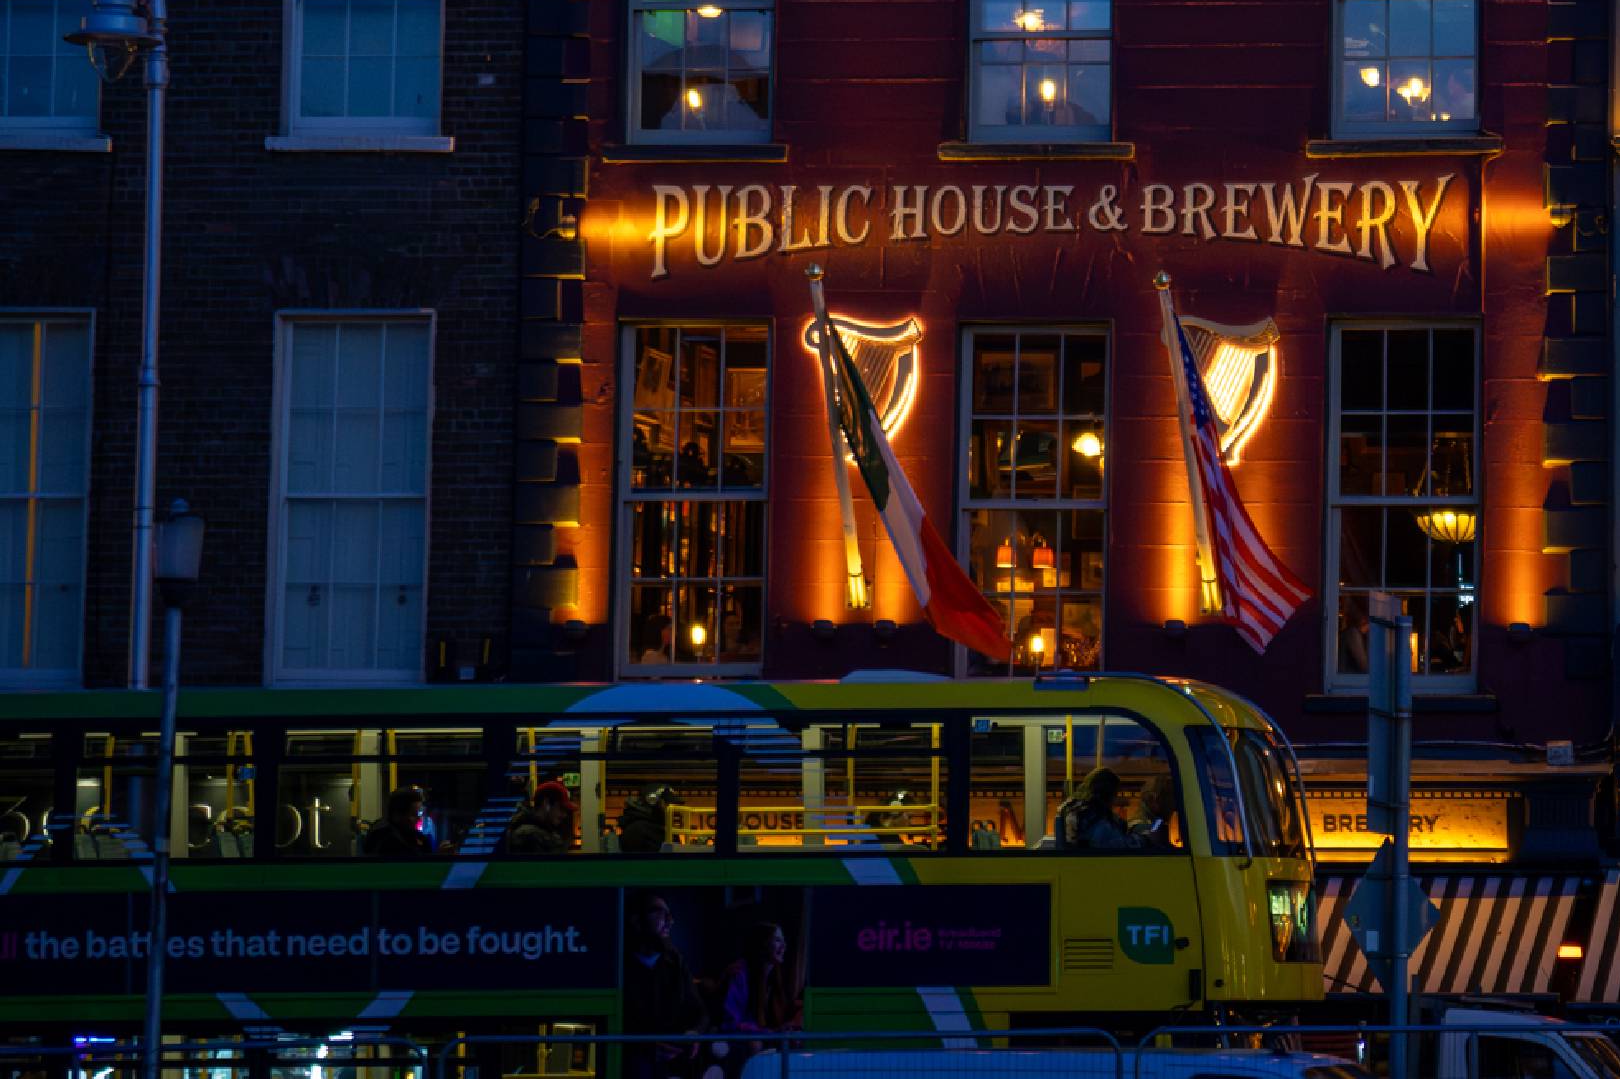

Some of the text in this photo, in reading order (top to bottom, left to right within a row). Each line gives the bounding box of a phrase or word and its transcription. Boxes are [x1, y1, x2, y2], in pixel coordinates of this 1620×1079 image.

[648, 172, 1456, 279] PUBLIC HOUSE & BREWERY
[1322, 813, 1439, 833] BRERY
[24, 931, 80, 960] the
[85, 930, 205, 959] battes
[211, 928, 282, 958] that
[286, 926, 369, 957] need
[376, 927, 413, 956] to
[417, 926, 461, 955] be
[466, 925, 588, 960] fought.
[1125, 925, 1170, 946] TFI
